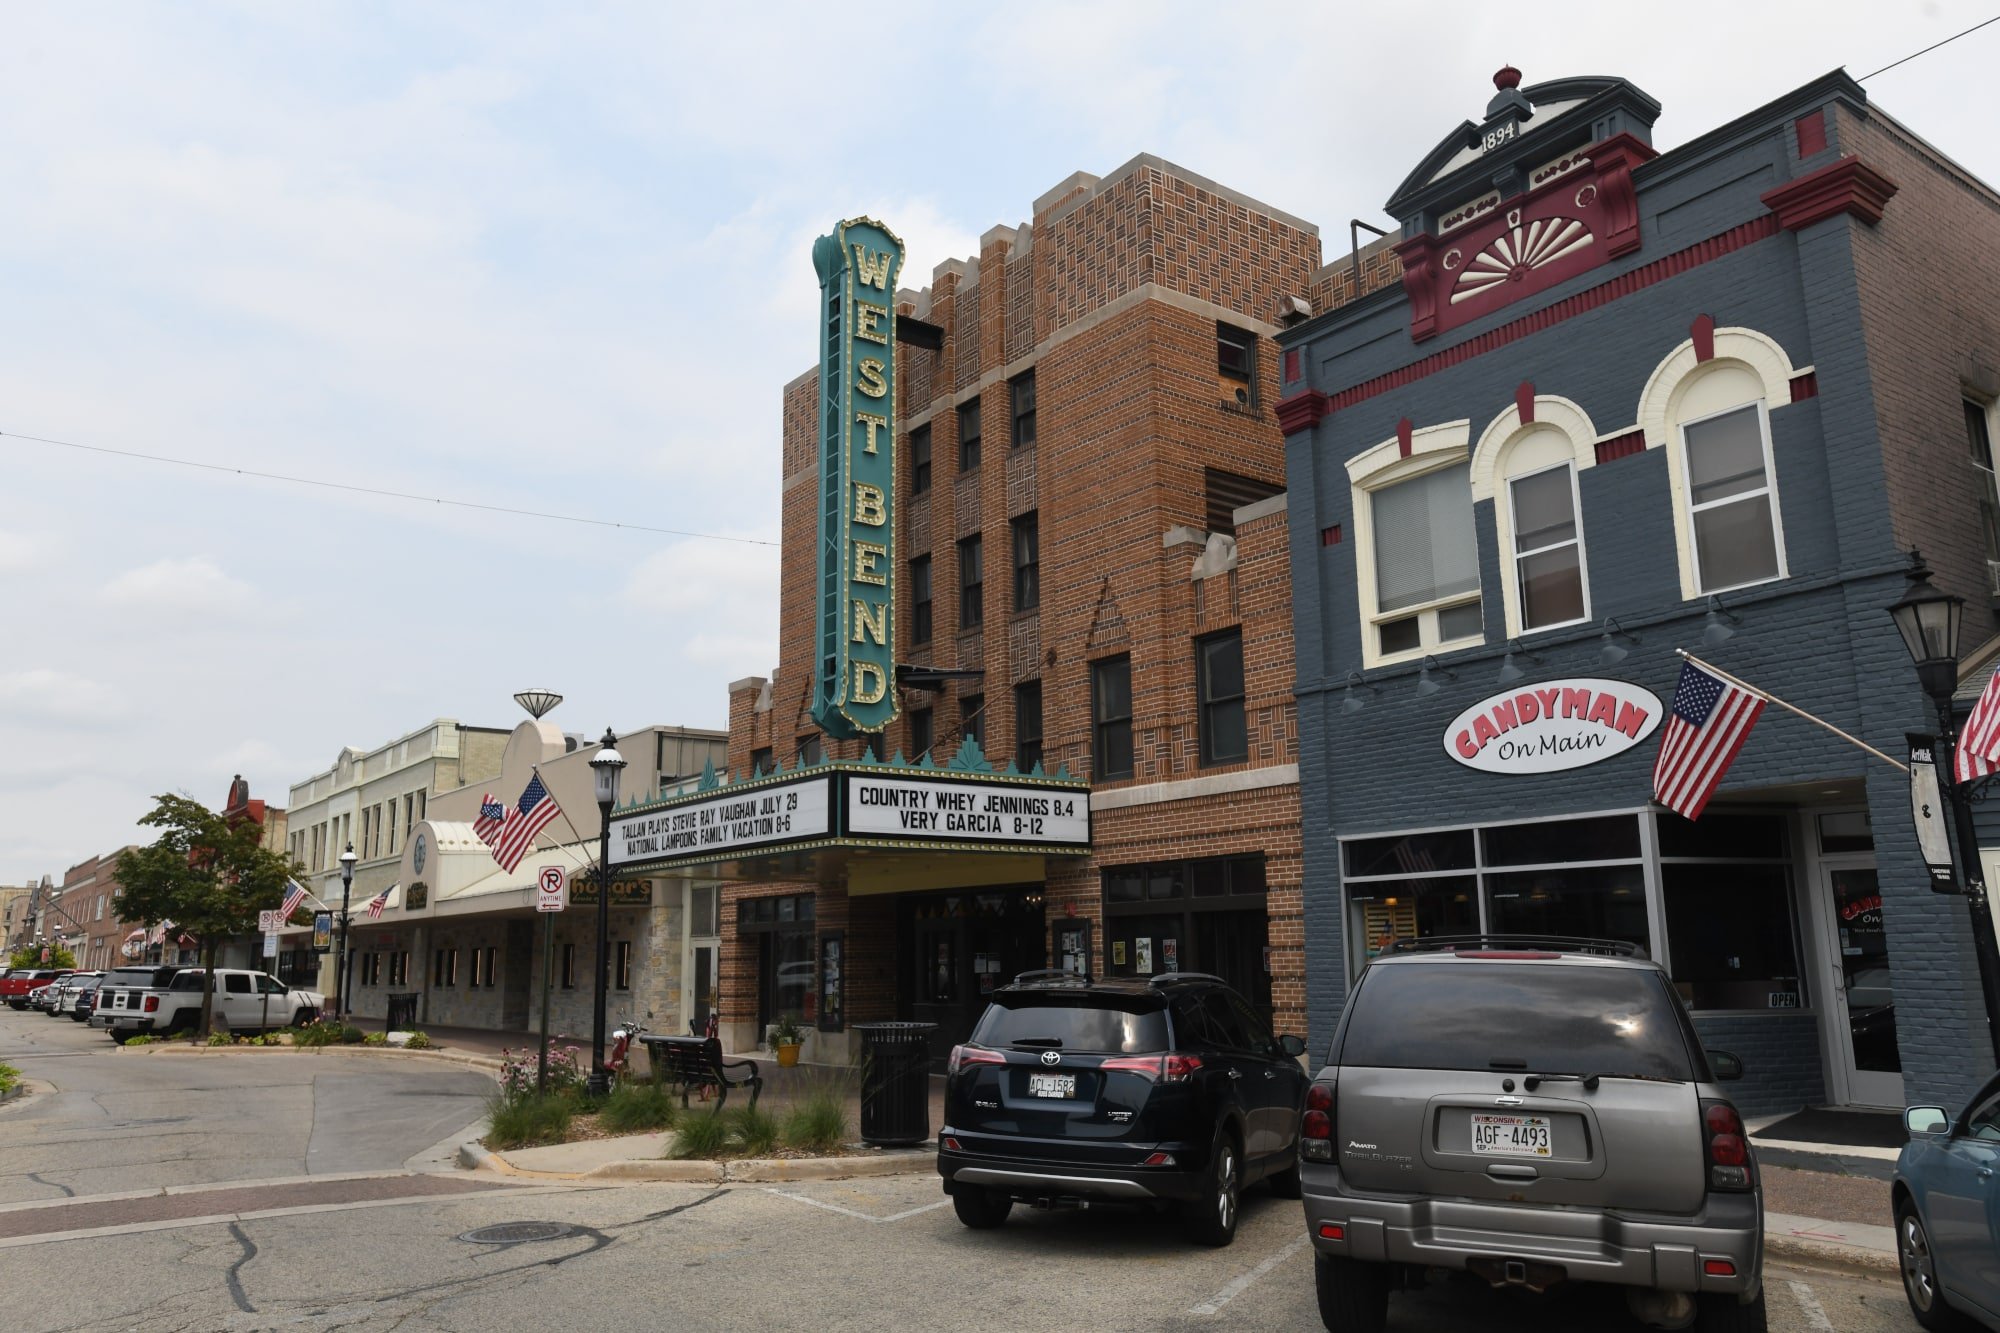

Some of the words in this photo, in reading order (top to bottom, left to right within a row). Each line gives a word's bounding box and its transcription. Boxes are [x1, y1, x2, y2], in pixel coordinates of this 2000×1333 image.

[1482, 122, 1514, 153] 1894
[852, 241, 894, 454] WEST
[850, 480, 889, 704] BEND
[1456, 688, 1649, 759] CANDYMAN
[1498, 741, 1536, 760] On
[1539, 731, 1607, 757] Main
[622, 821, 646, 840] TALLAN
[648, 817, 670, 835] PLAYS
[673, 812, 696, 831] STEVIE
[700, 808, 715, 826] RAY
[720, 800, 756, 822] VAUGHAN
[760, 795, 781, 815] JULY
[787, 792, 798, 811] 29
[860, 787, 929, 808] COUNTRY
[936, 792, 976, 812] WHEY
[984, 795, 1048, 816] JENNINGS
[1054, 800, 1074, 817] 8.4
[627, 838, 658, 856] NATIONAL
[662, 830, 697, 850] LAMPOONS
[700, 825, 728, 845] FAMILY
[732, 817, 773, 840] VACATION
[776, 814, 791, 833] 8-6
[900, 811, 939, 830] VERY
[946, 813, 1001, 833] GARCIA
[1014, 817, 1043, 835] 8-12
[571, 879, 650, 897] hoar's
[1771, 993, 1795, 1007] OPEN
[1474, 1115, 1516, 1124] WISCONSIN
[1476, 1125, 1548, 1147] AGF-4493
